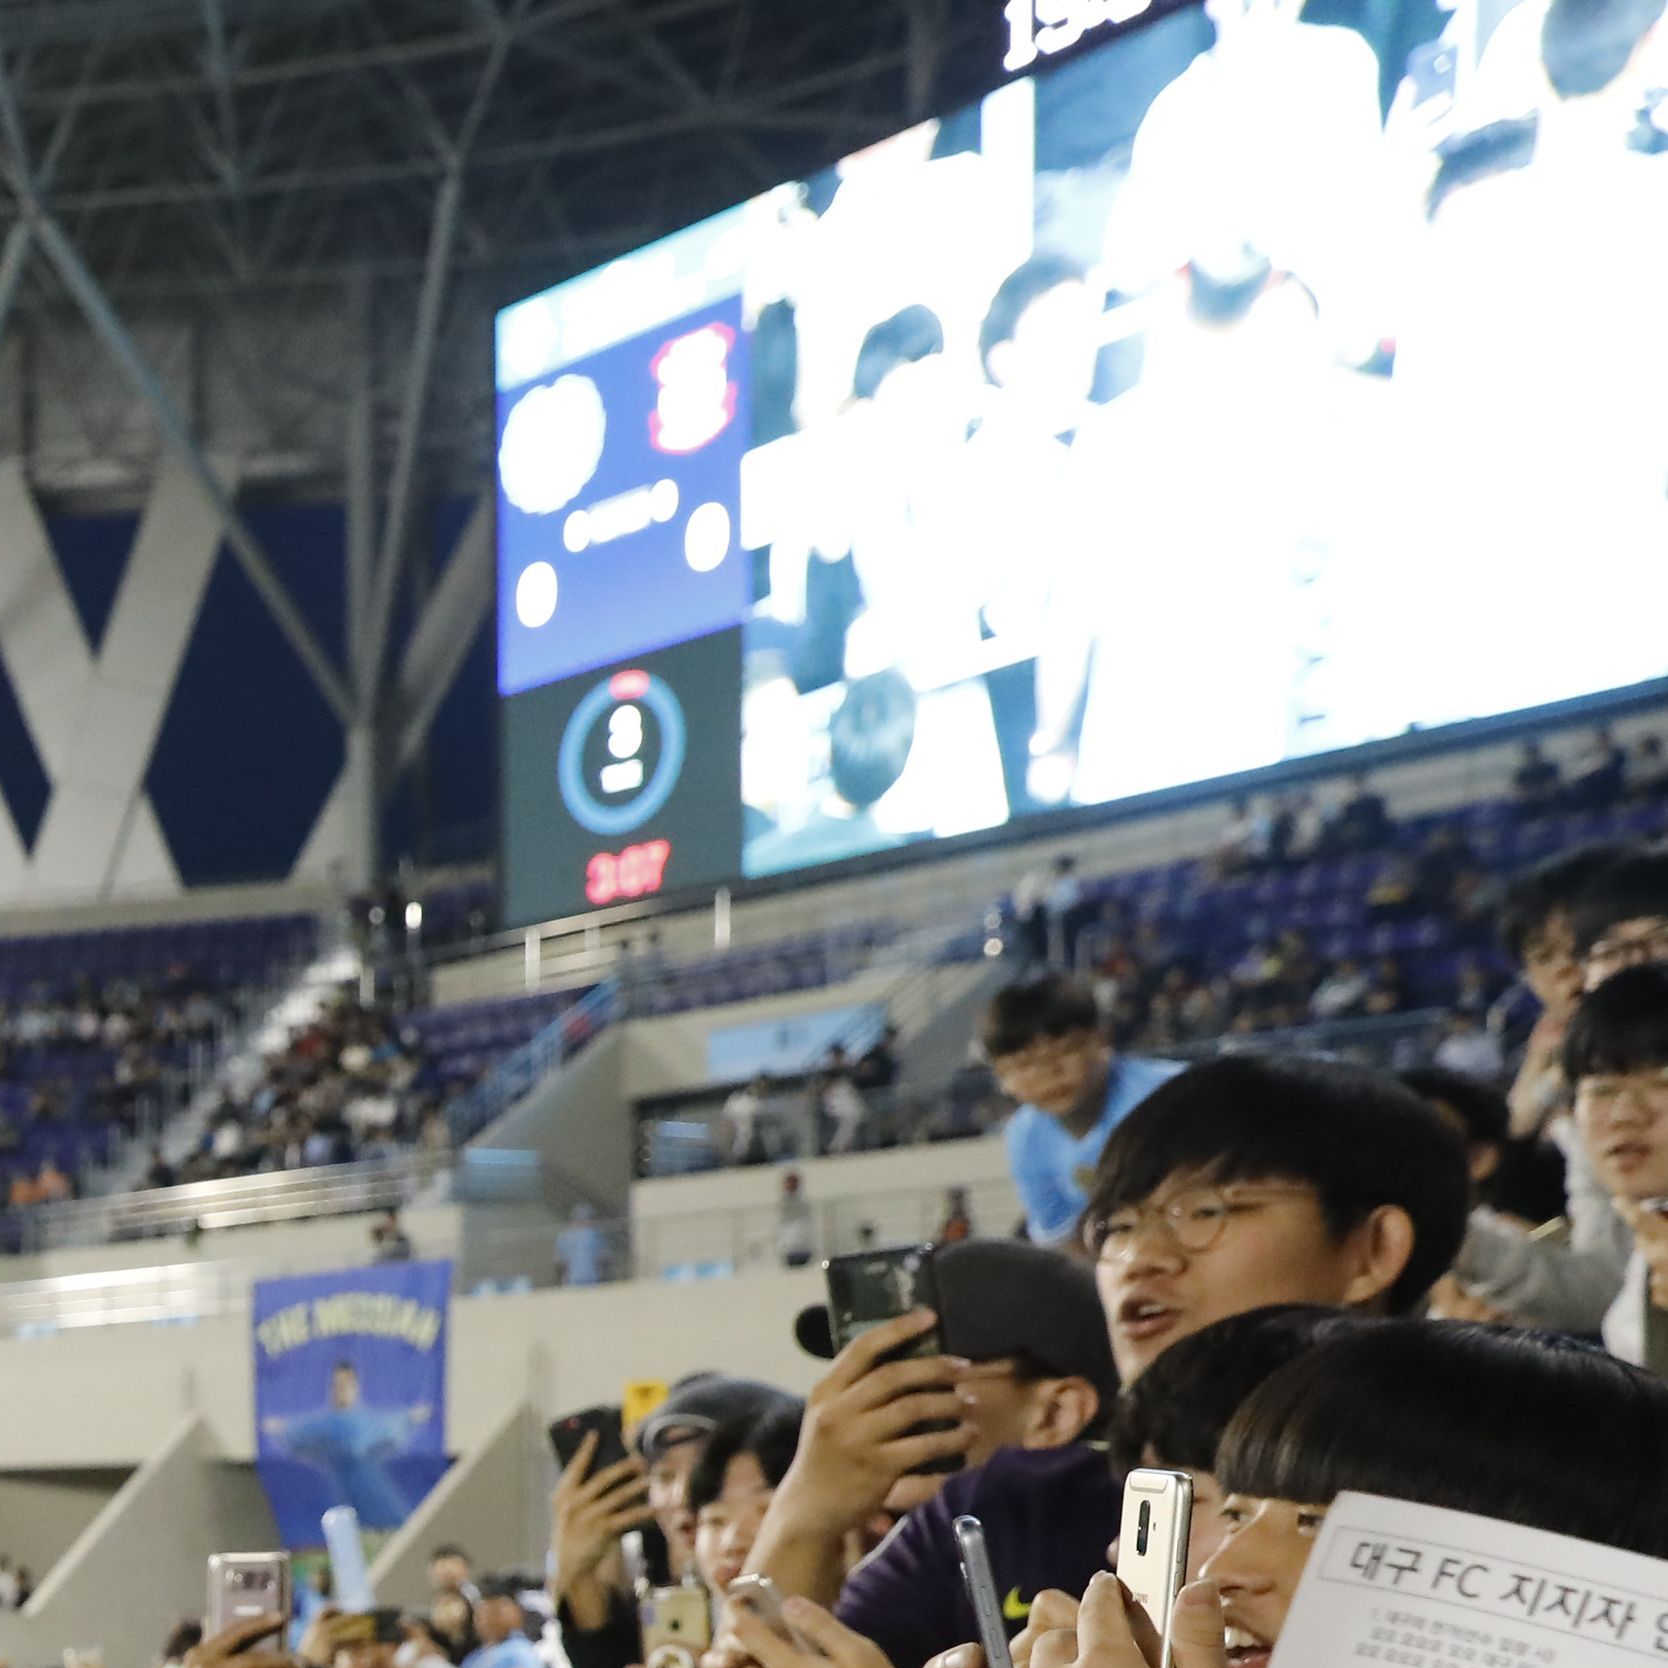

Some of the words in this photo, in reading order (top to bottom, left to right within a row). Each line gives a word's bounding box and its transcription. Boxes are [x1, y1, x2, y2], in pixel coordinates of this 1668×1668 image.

[1349, 1542, 1422, 1584] 대구
[1431, 1559, 1486, 1599] FC
[1500, 1574, 1637, 1638] 지지자
